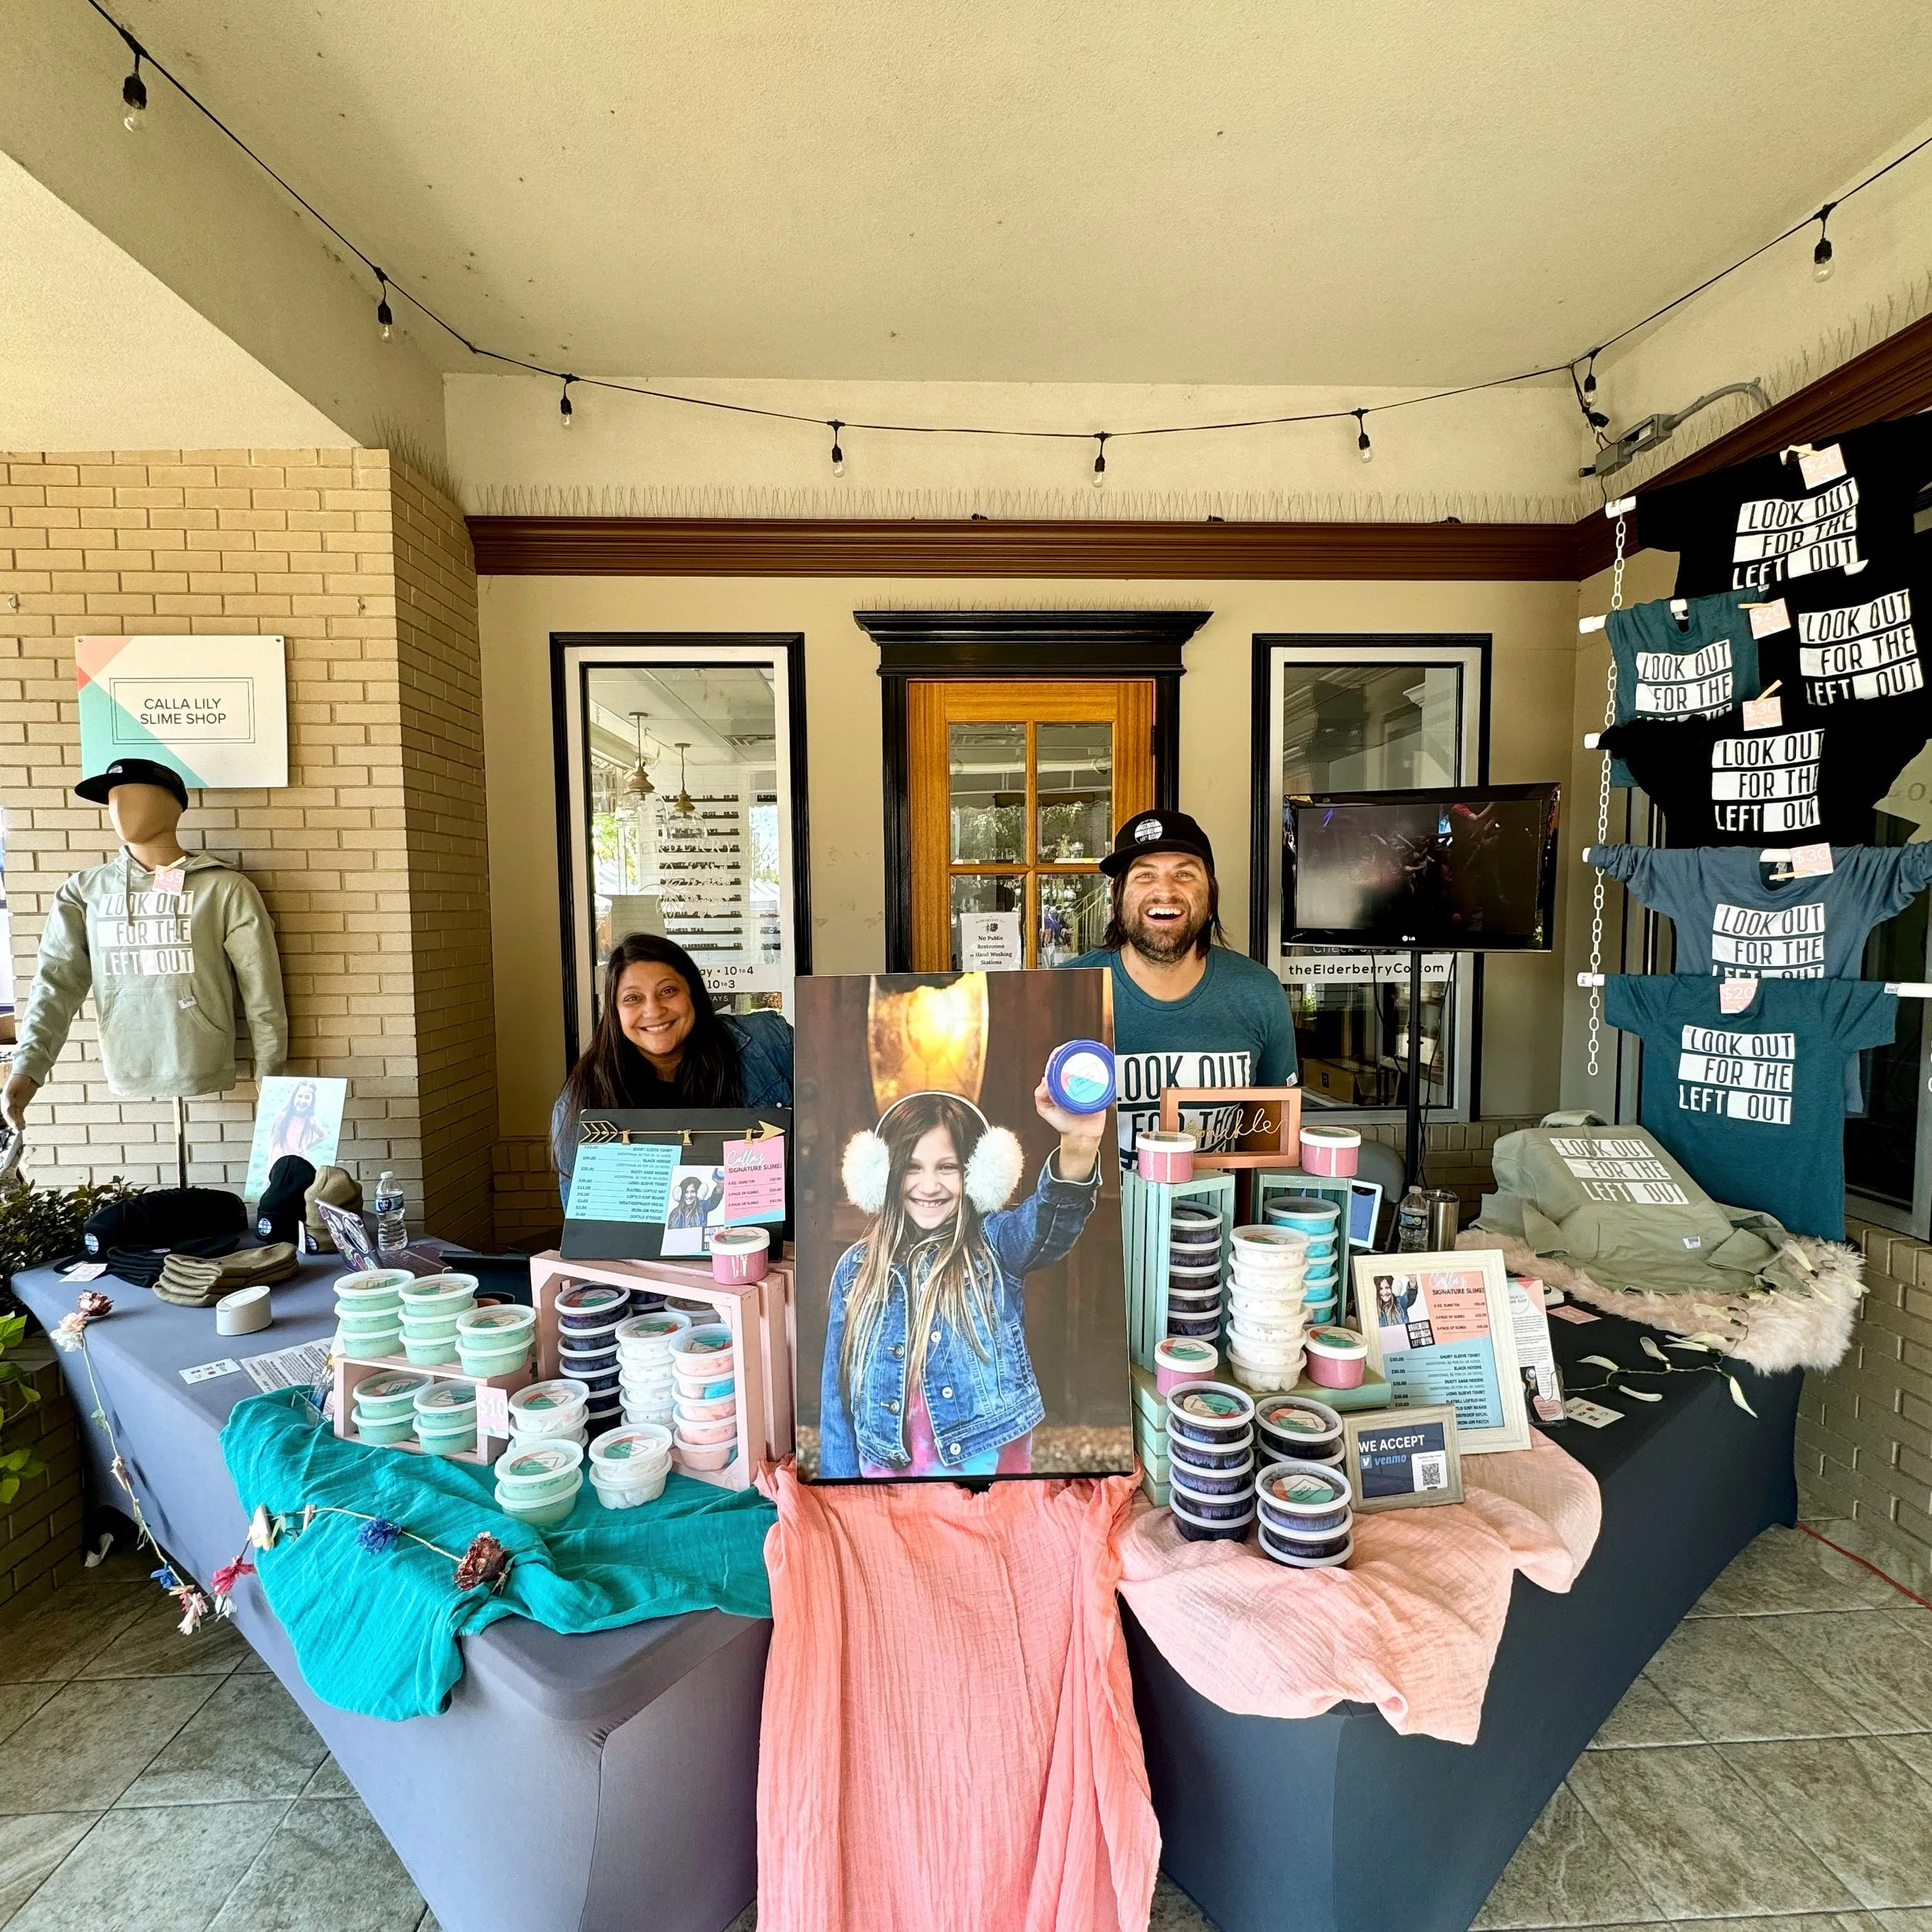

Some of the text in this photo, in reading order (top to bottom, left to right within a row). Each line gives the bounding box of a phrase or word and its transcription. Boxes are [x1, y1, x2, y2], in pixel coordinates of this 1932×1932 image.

[1748, 481, 1854, 529] LOOK OUT
[1761, 508, 1855, 557] FOR THE
[1733, 539, 1853, 590] LEFT OUT
[1753, 605, 1784, 624] $20
[1806, 591, 1907, 642] LOOK OUT
[1642, 642, 1727, 680] LOOK OUT
[1821, 627, 1915, 675] FOR THE
[1653, 674, 1730, 711] FOR THE
[1805, 662, 1917, 706] LEFT OUT
[144, 698, 222, 709] CALLA LILY
[1745, 700, 1778, 718] $30
[140, 713, 226, 725] SLIME SHOP
[1723, 731, 1825, 766] LOOK OUT
[1739, 772, 1774, 798] FOR
[1714, 804, 1761, 832] LEFT
[1794, 846, 1829, 864] $30
[156, 871, 183, 885] $35
[116, 920, 191, 945] FOR THE
[1721, 905, 1821, 936] LOOK OUT
[102, 949, 192, 976] LEFT OUT
[1734, 937, 1822, 965] FOR THE
[724, 966, 737, 975] 10
[747, 966, 754, 975] 4
[707, 980, 720, 989] 10
[728, 980, 736, 988] 3
[1690, 1029, 1792, 1058] LOOK OUT
[1117, 1054, 1184, 1102] OOK
[1198, 1054, 1248, 1088] OUT
[1703, 1057, 1791, 1090] FOR THE
[1679, 1084, 1789, 1123] LEFT OUT
[1558, 1139, 1649, 1157] LOOK OUT
[728, 1165, 763, 1173] SIGNATURE
[1587, 1160, 1668, 1179] FOR THE
[1580, 1180, 1685, 1203] LEFT OUT
[478, 1393, 506, 1418] $10
[1358, 1434, 1425, 1453] WE ACCEPT
[1374, 1454, 1407, 1466] venmo
